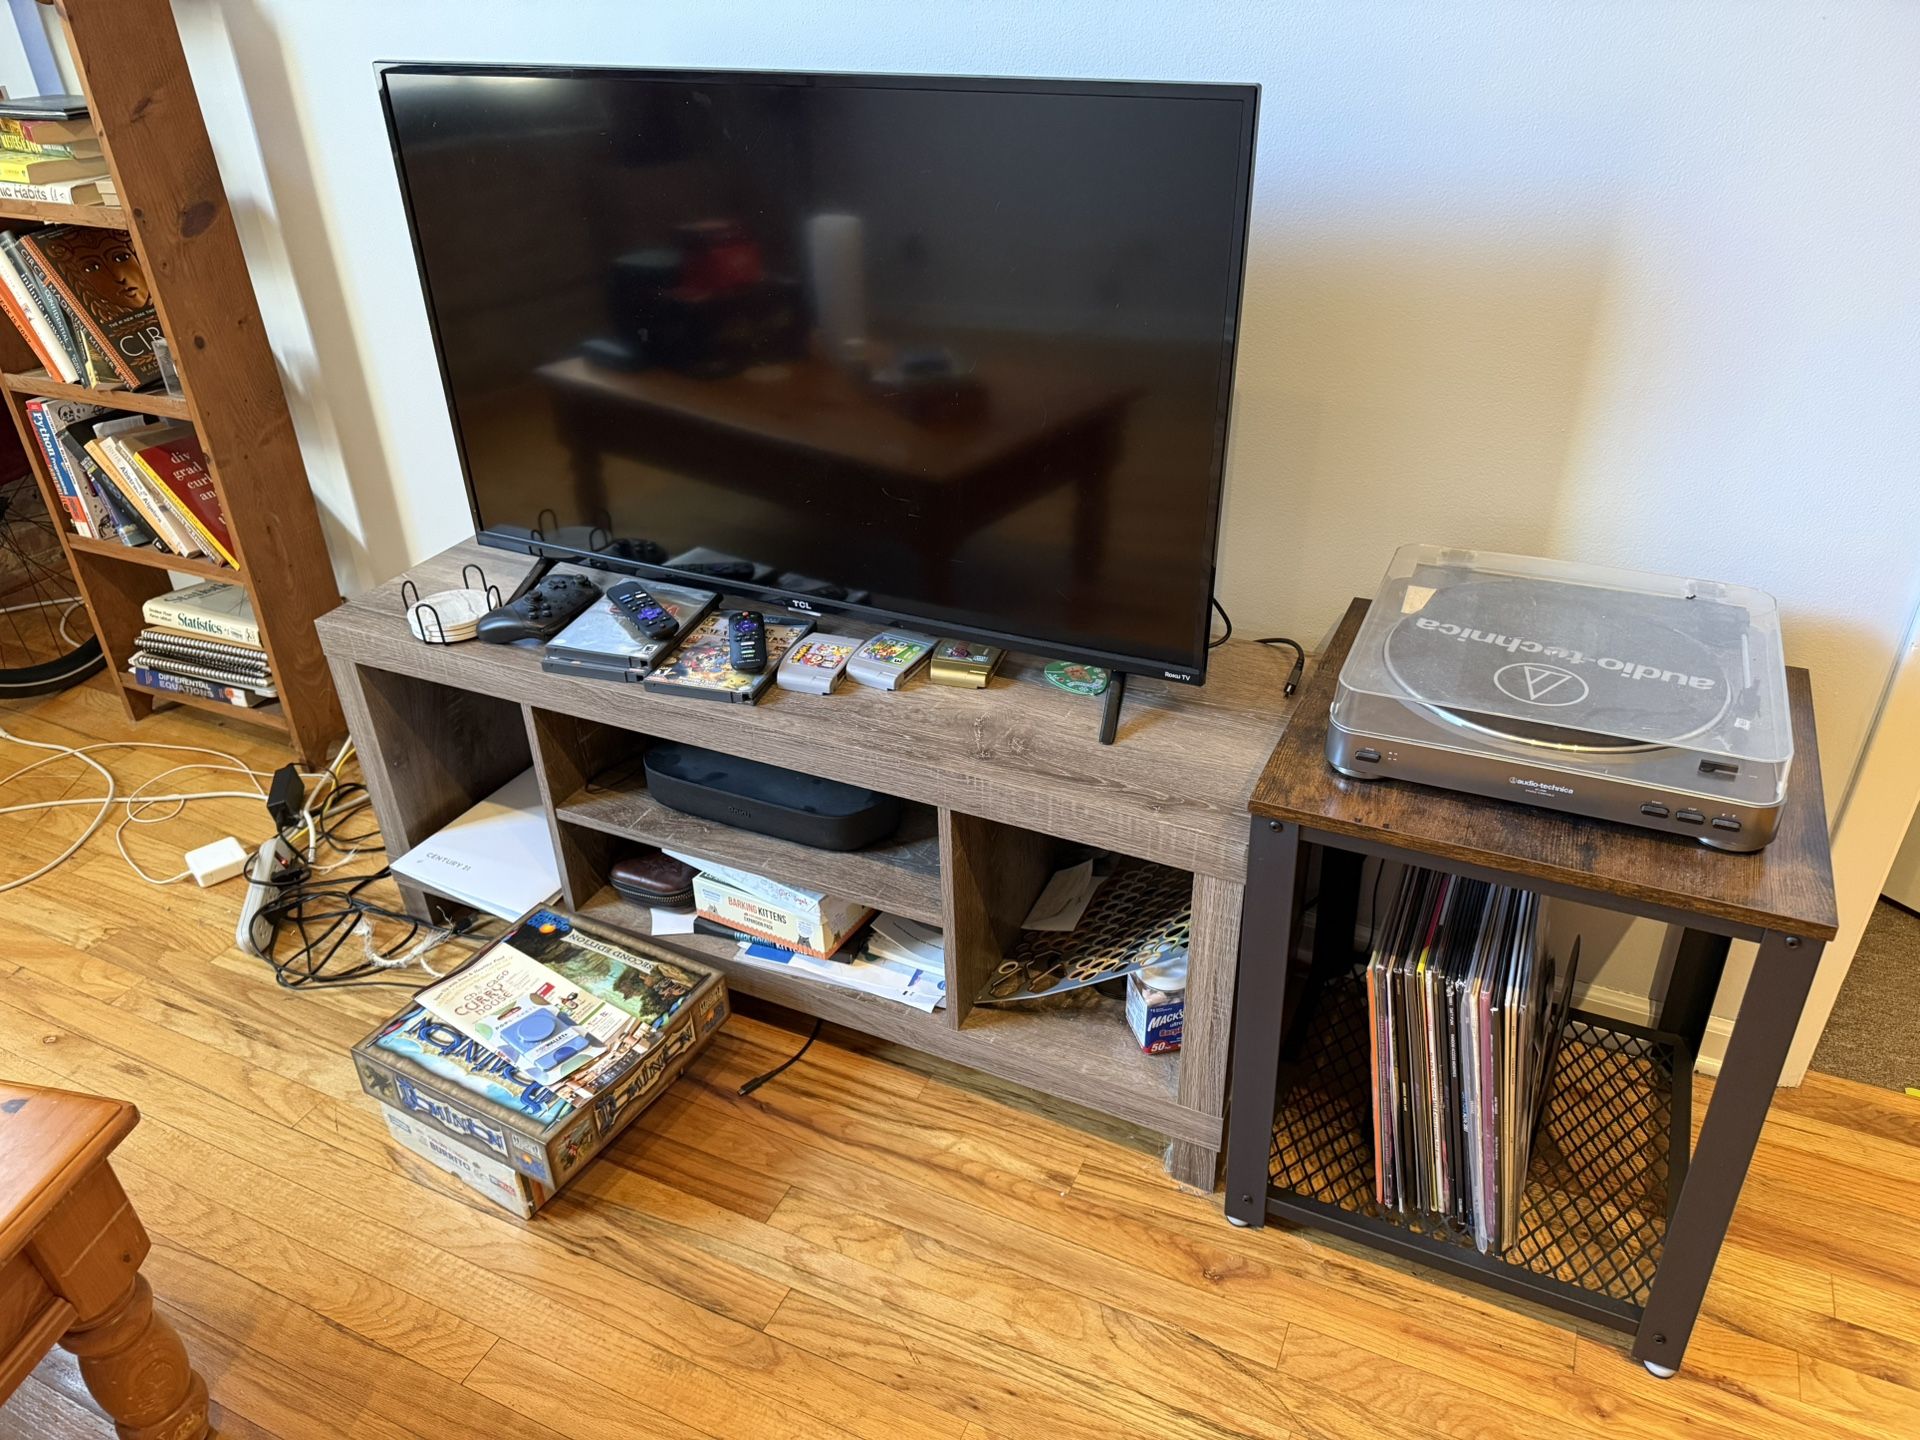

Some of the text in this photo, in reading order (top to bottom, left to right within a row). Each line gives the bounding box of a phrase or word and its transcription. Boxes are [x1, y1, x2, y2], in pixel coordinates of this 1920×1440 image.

[14, 186, 47, 201] Habits
[20, 273, 45, 313] infinite
[20, 249, 45, 281] CIRCE
[48, 285, 88, 333] MADELINE
[88, 336, 117, 369] MILLER
[45, 290, 70, 346] CONFIDENTIAL
[119, 326, 164, 357] CIR
[31, 411, 57, 458] Python
[50, 456, 70, 496] Programming
[170, 451, 192, 465] div
[173, 462, 203, 482] grad
[187, 474, 214, 490] curl
[119, 465, 145, 498] Abstract
[142, 495, 163, 523] Algebra
[200, 490, 217, 502] an
[792, 600, 812, 610] TCL
[177, 611, 223, 635] Statistics
[1415, 617, 1717, 691] audio-technica
[158, 672, 212, 691] DIFFERENTIAL
[1164, 671, 1181, 679] Roku
[159, 679, 215, 698] EQUATIONS
[1517, 777, 1574, 795] audio-technica
[426, 851, 463, 869] CENTURY
[727, 896, 758, 914] BARKING
[757, 906, 787, 924] KITTENS
[569, 933, 655, 970] SECOND EDITION
[454, 982, 505, 1018] CURRY
[475, 991, 513, 1016] HOUSE
[1147, 1008, 1184, 1032] MACK'S
[1151, 1041, 1166, 1052] 50
[595, 1026, 693, 1133] DOMINION
[397, 1076, 504, 1151] DOMINION
[428, 1140, 472, 1172] BURRITO
